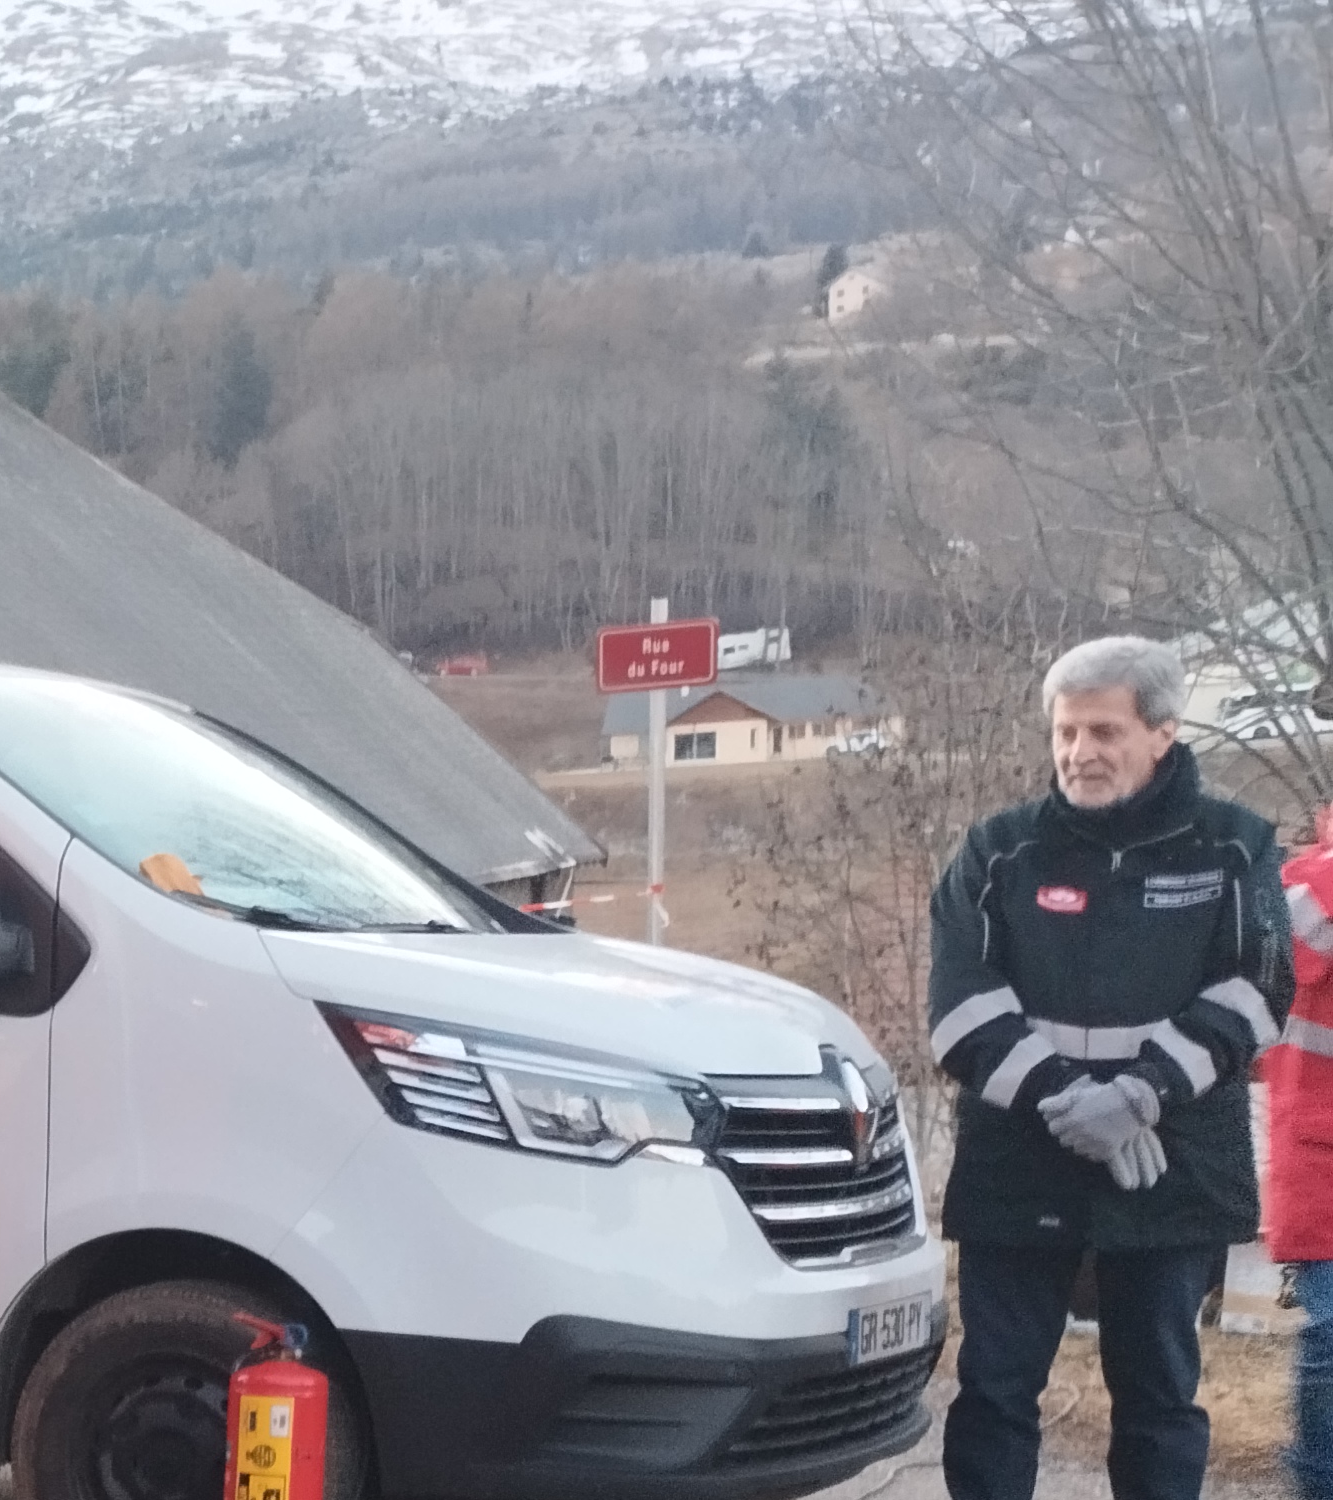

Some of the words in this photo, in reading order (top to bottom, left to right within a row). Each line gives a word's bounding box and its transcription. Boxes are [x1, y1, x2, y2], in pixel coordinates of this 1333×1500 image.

[641, 636, 671, 656] Rue
[626, 660, 646, 679] du
[650, 658, 686, 677] Four
